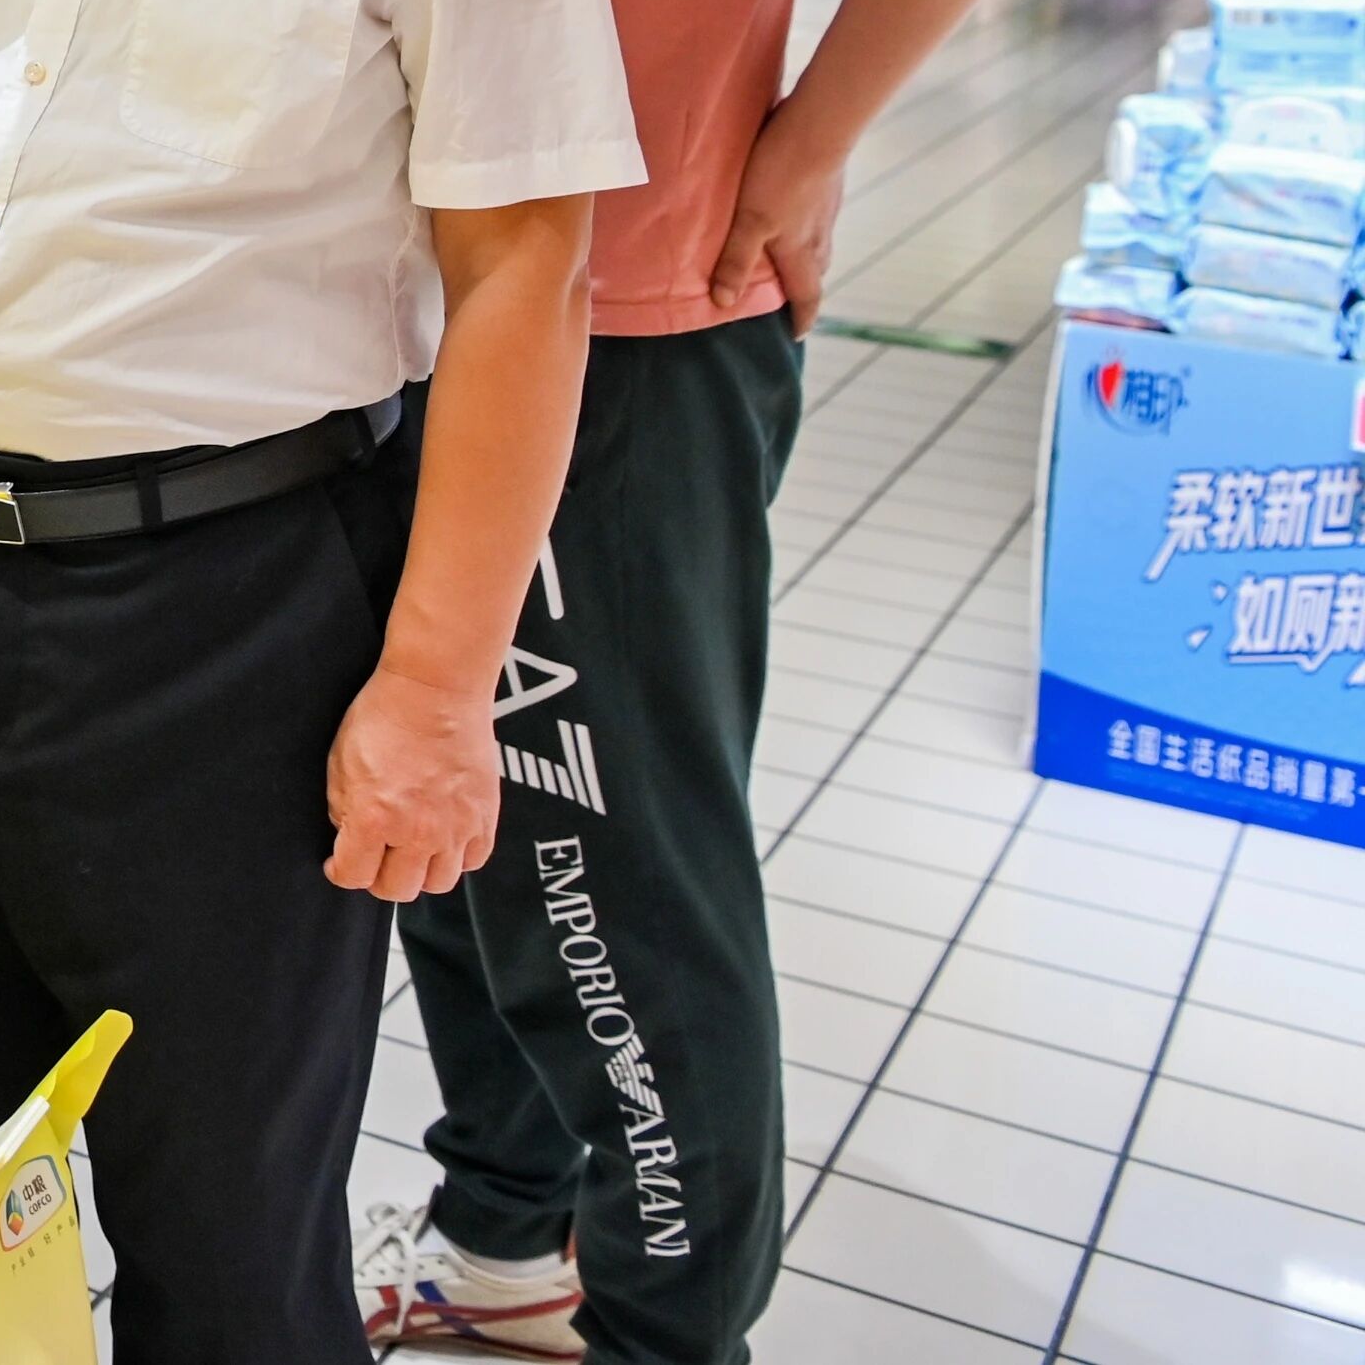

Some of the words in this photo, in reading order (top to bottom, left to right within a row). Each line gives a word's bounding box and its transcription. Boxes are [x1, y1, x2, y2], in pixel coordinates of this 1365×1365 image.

[1144, 466, 1365, 582] 柔软新世
[1106, 719, 1365, 791] 全国生活纸品销量第
[535, 835, 637, 1049] EMPORIO
[620, 1101, 691, 1260] ARMANI
[22, 1174, 47, 1201] 中粮
[28, 1193, 53, 1216] COFCO
